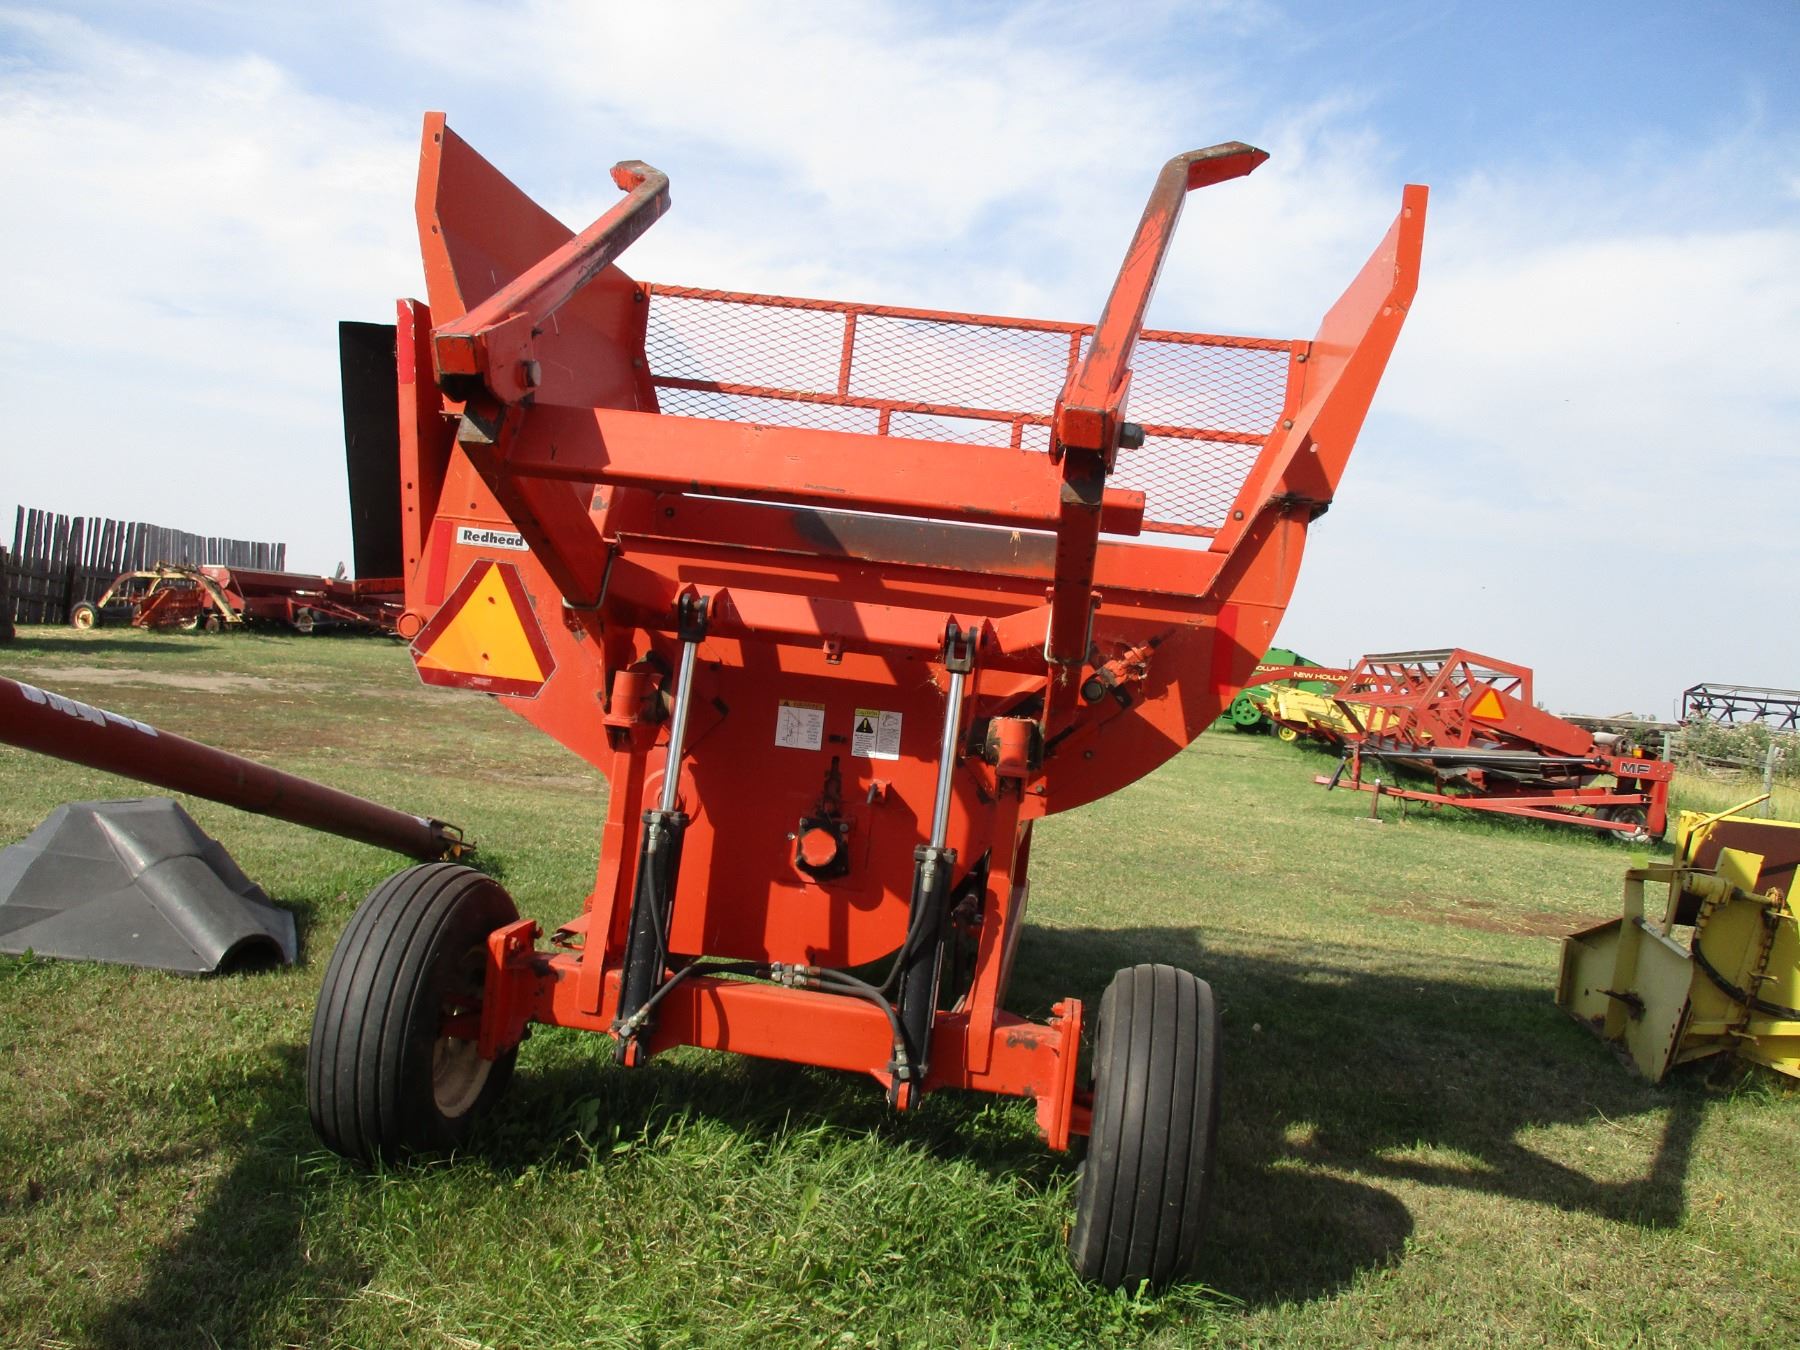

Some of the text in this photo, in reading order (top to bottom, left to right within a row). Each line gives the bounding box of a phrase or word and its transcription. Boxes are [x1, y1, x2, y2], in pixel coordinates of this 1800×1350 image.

[463, 529, 524, 546] Redhead
[1293, 671, 1314, 679] NEW
[1620, 761, 1651, 775] MF
